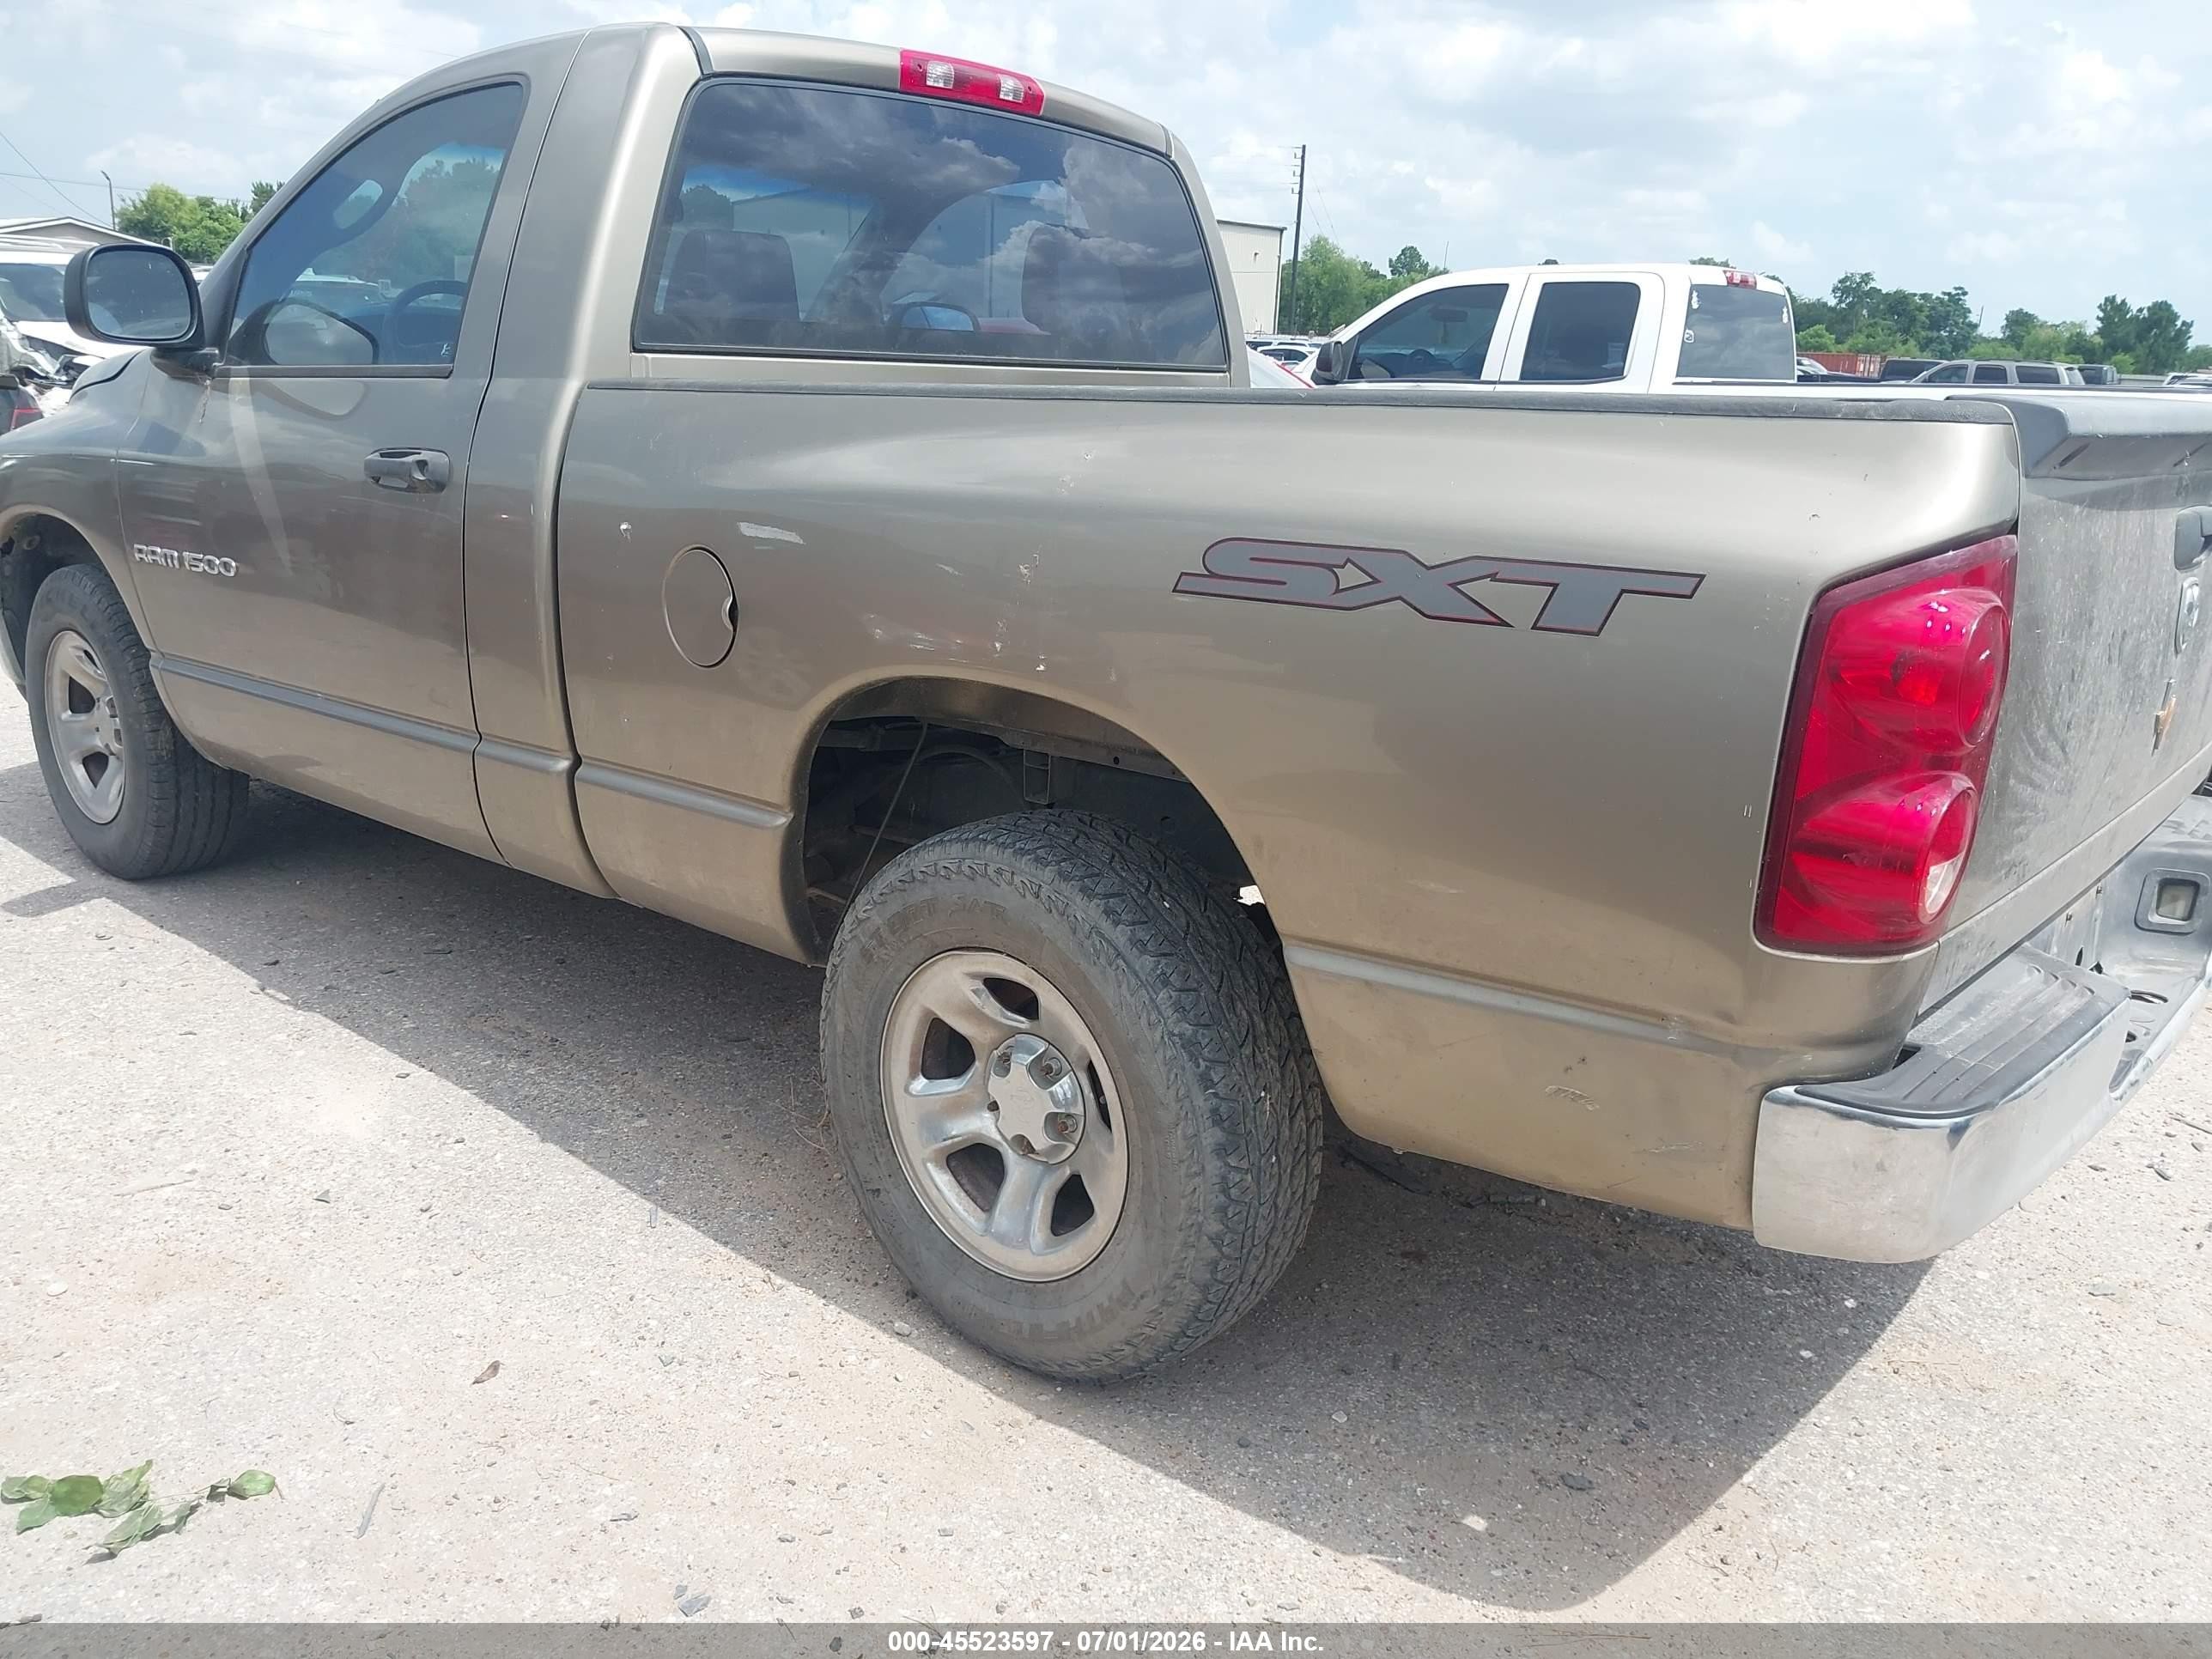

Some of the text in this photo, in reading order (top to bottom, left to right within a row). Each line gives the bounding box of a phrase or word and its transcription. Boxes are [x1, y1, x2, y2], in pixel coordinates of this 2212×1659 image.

[133, 544, 237, 577] RAM 1500
[1173, 537, 1706, 636] SXT
